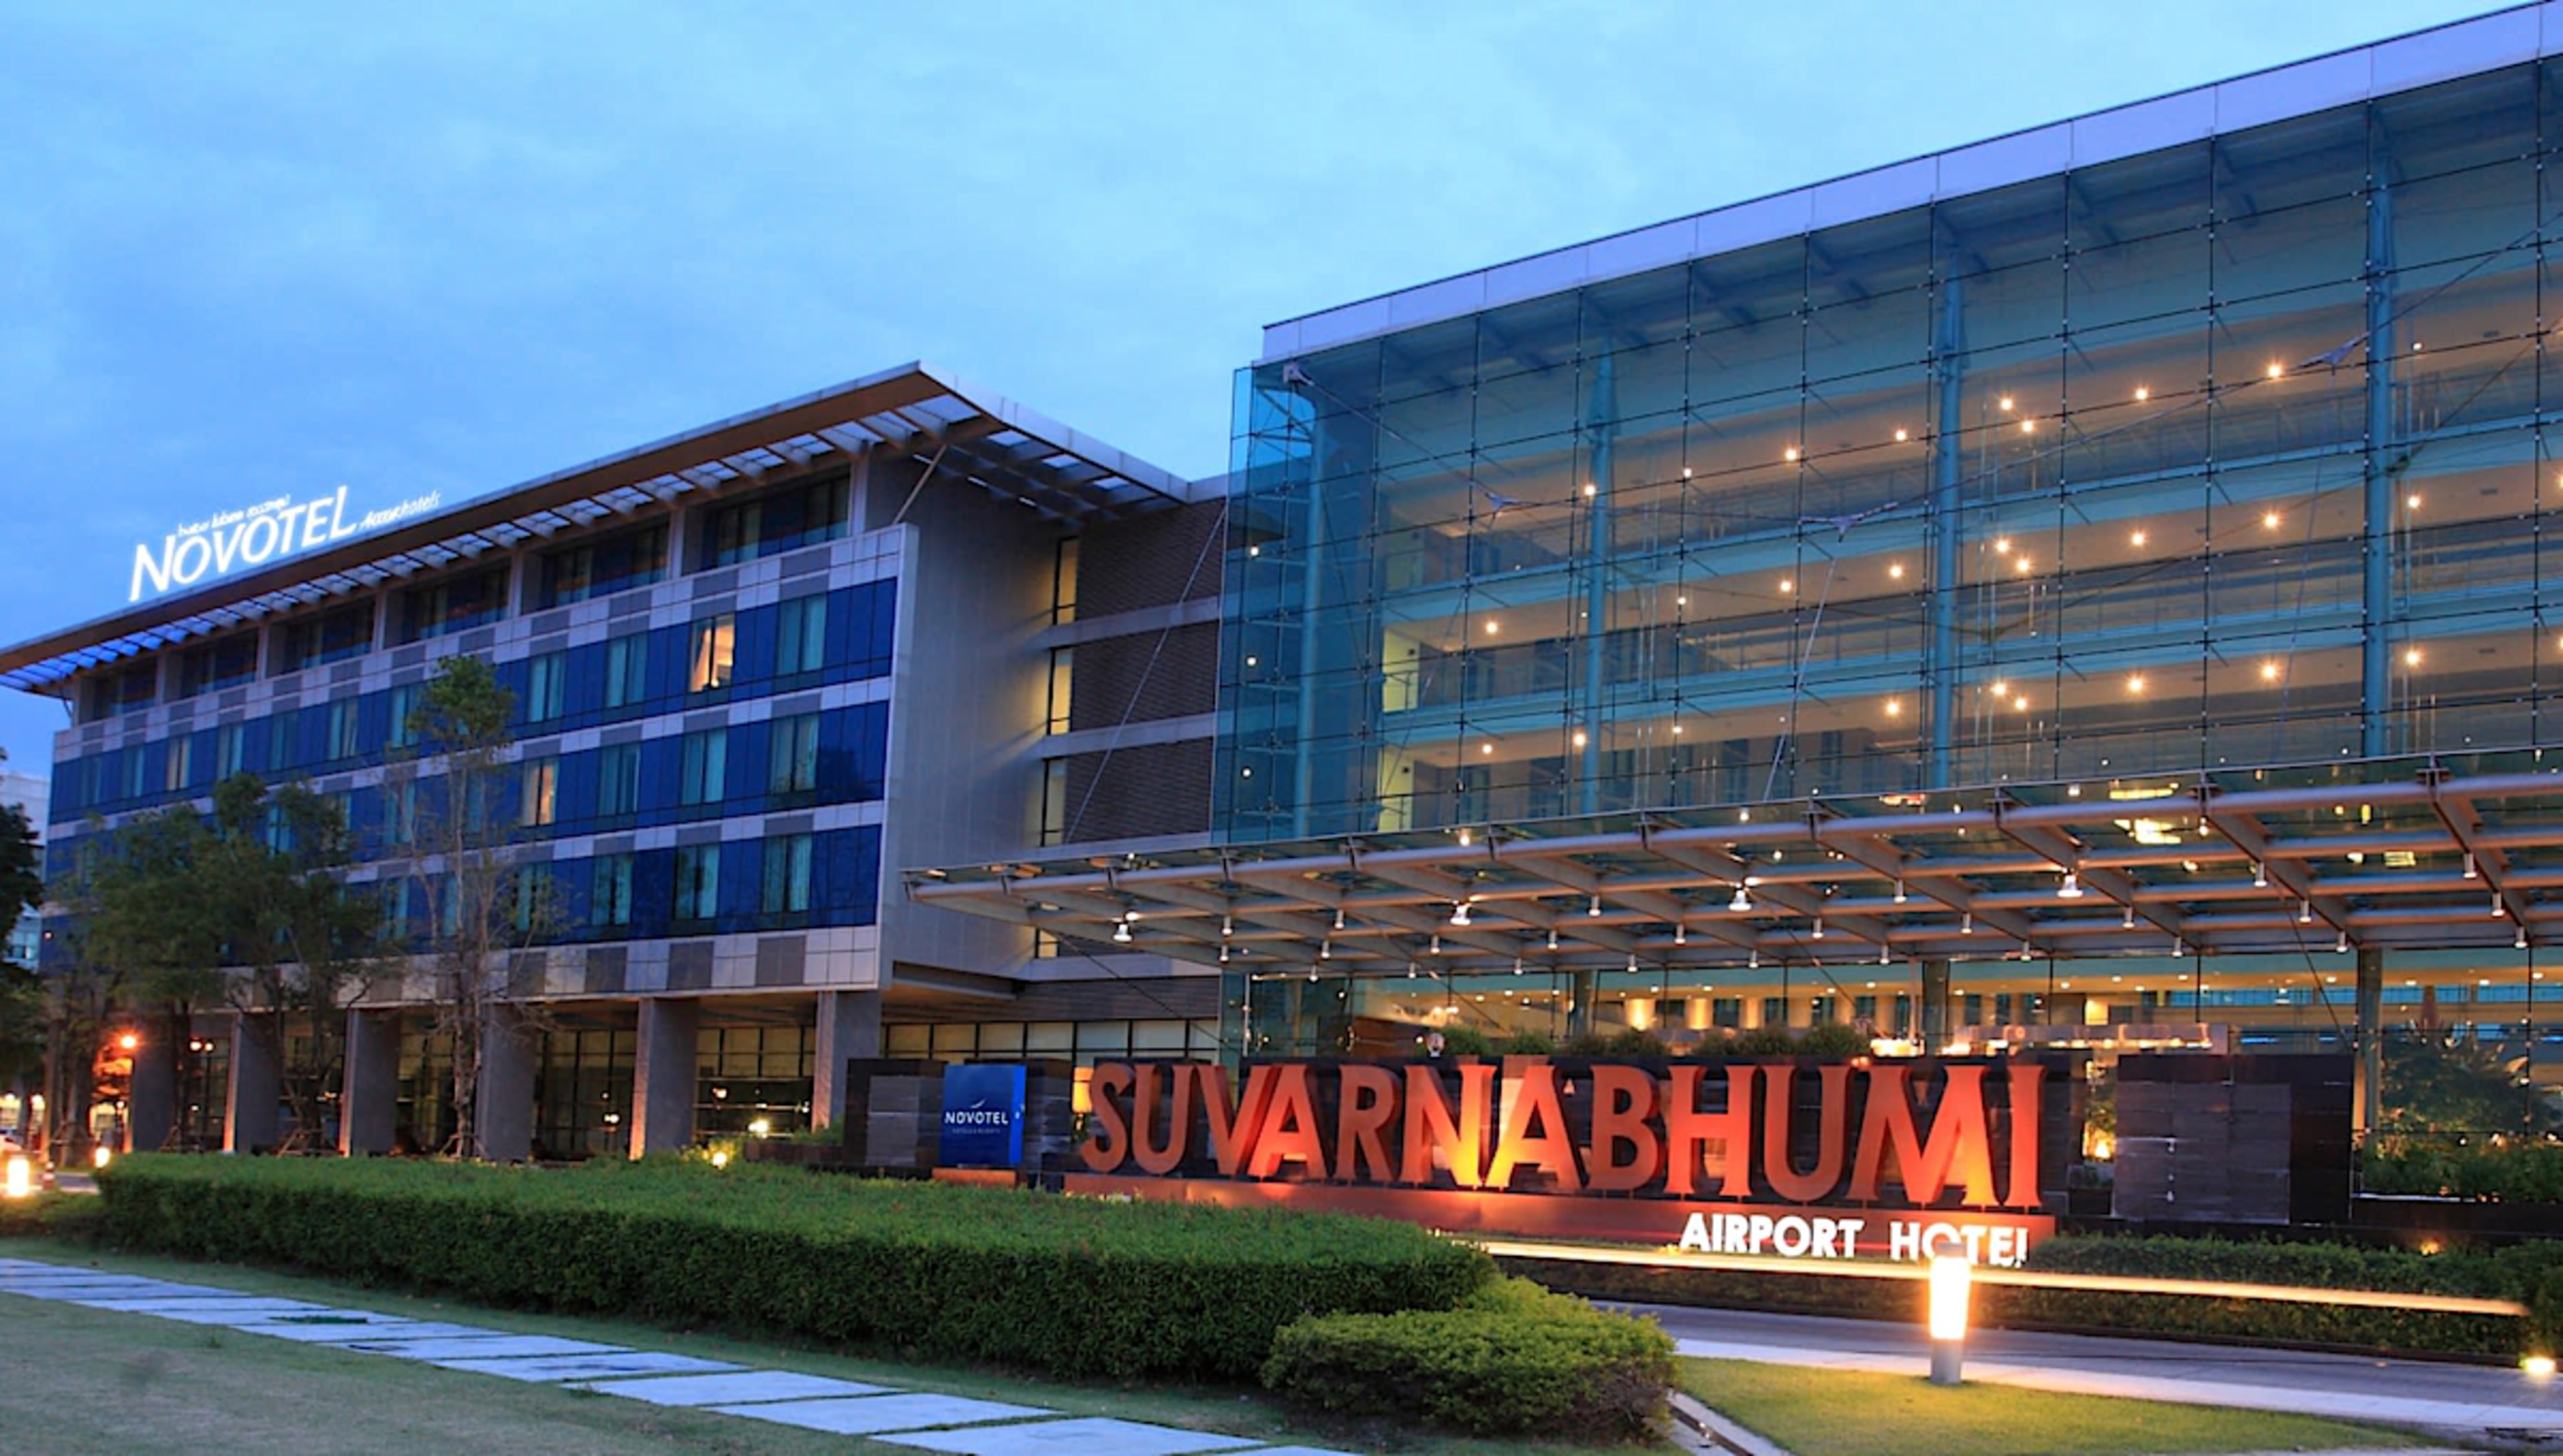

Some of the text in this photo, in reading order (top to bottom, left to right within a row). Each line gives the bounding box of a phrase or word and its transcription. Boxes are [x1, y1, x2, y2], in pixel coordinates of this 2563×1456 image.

[129, 485, 356, 602] NOVOTEL
[943, 1111, 1009, 1126] NOVOTEL
[1079, 1061, 2045, 1208] SUVARNABHUMI
[1678, 1212, 2030, 1268] AIRPORT HOTEL
